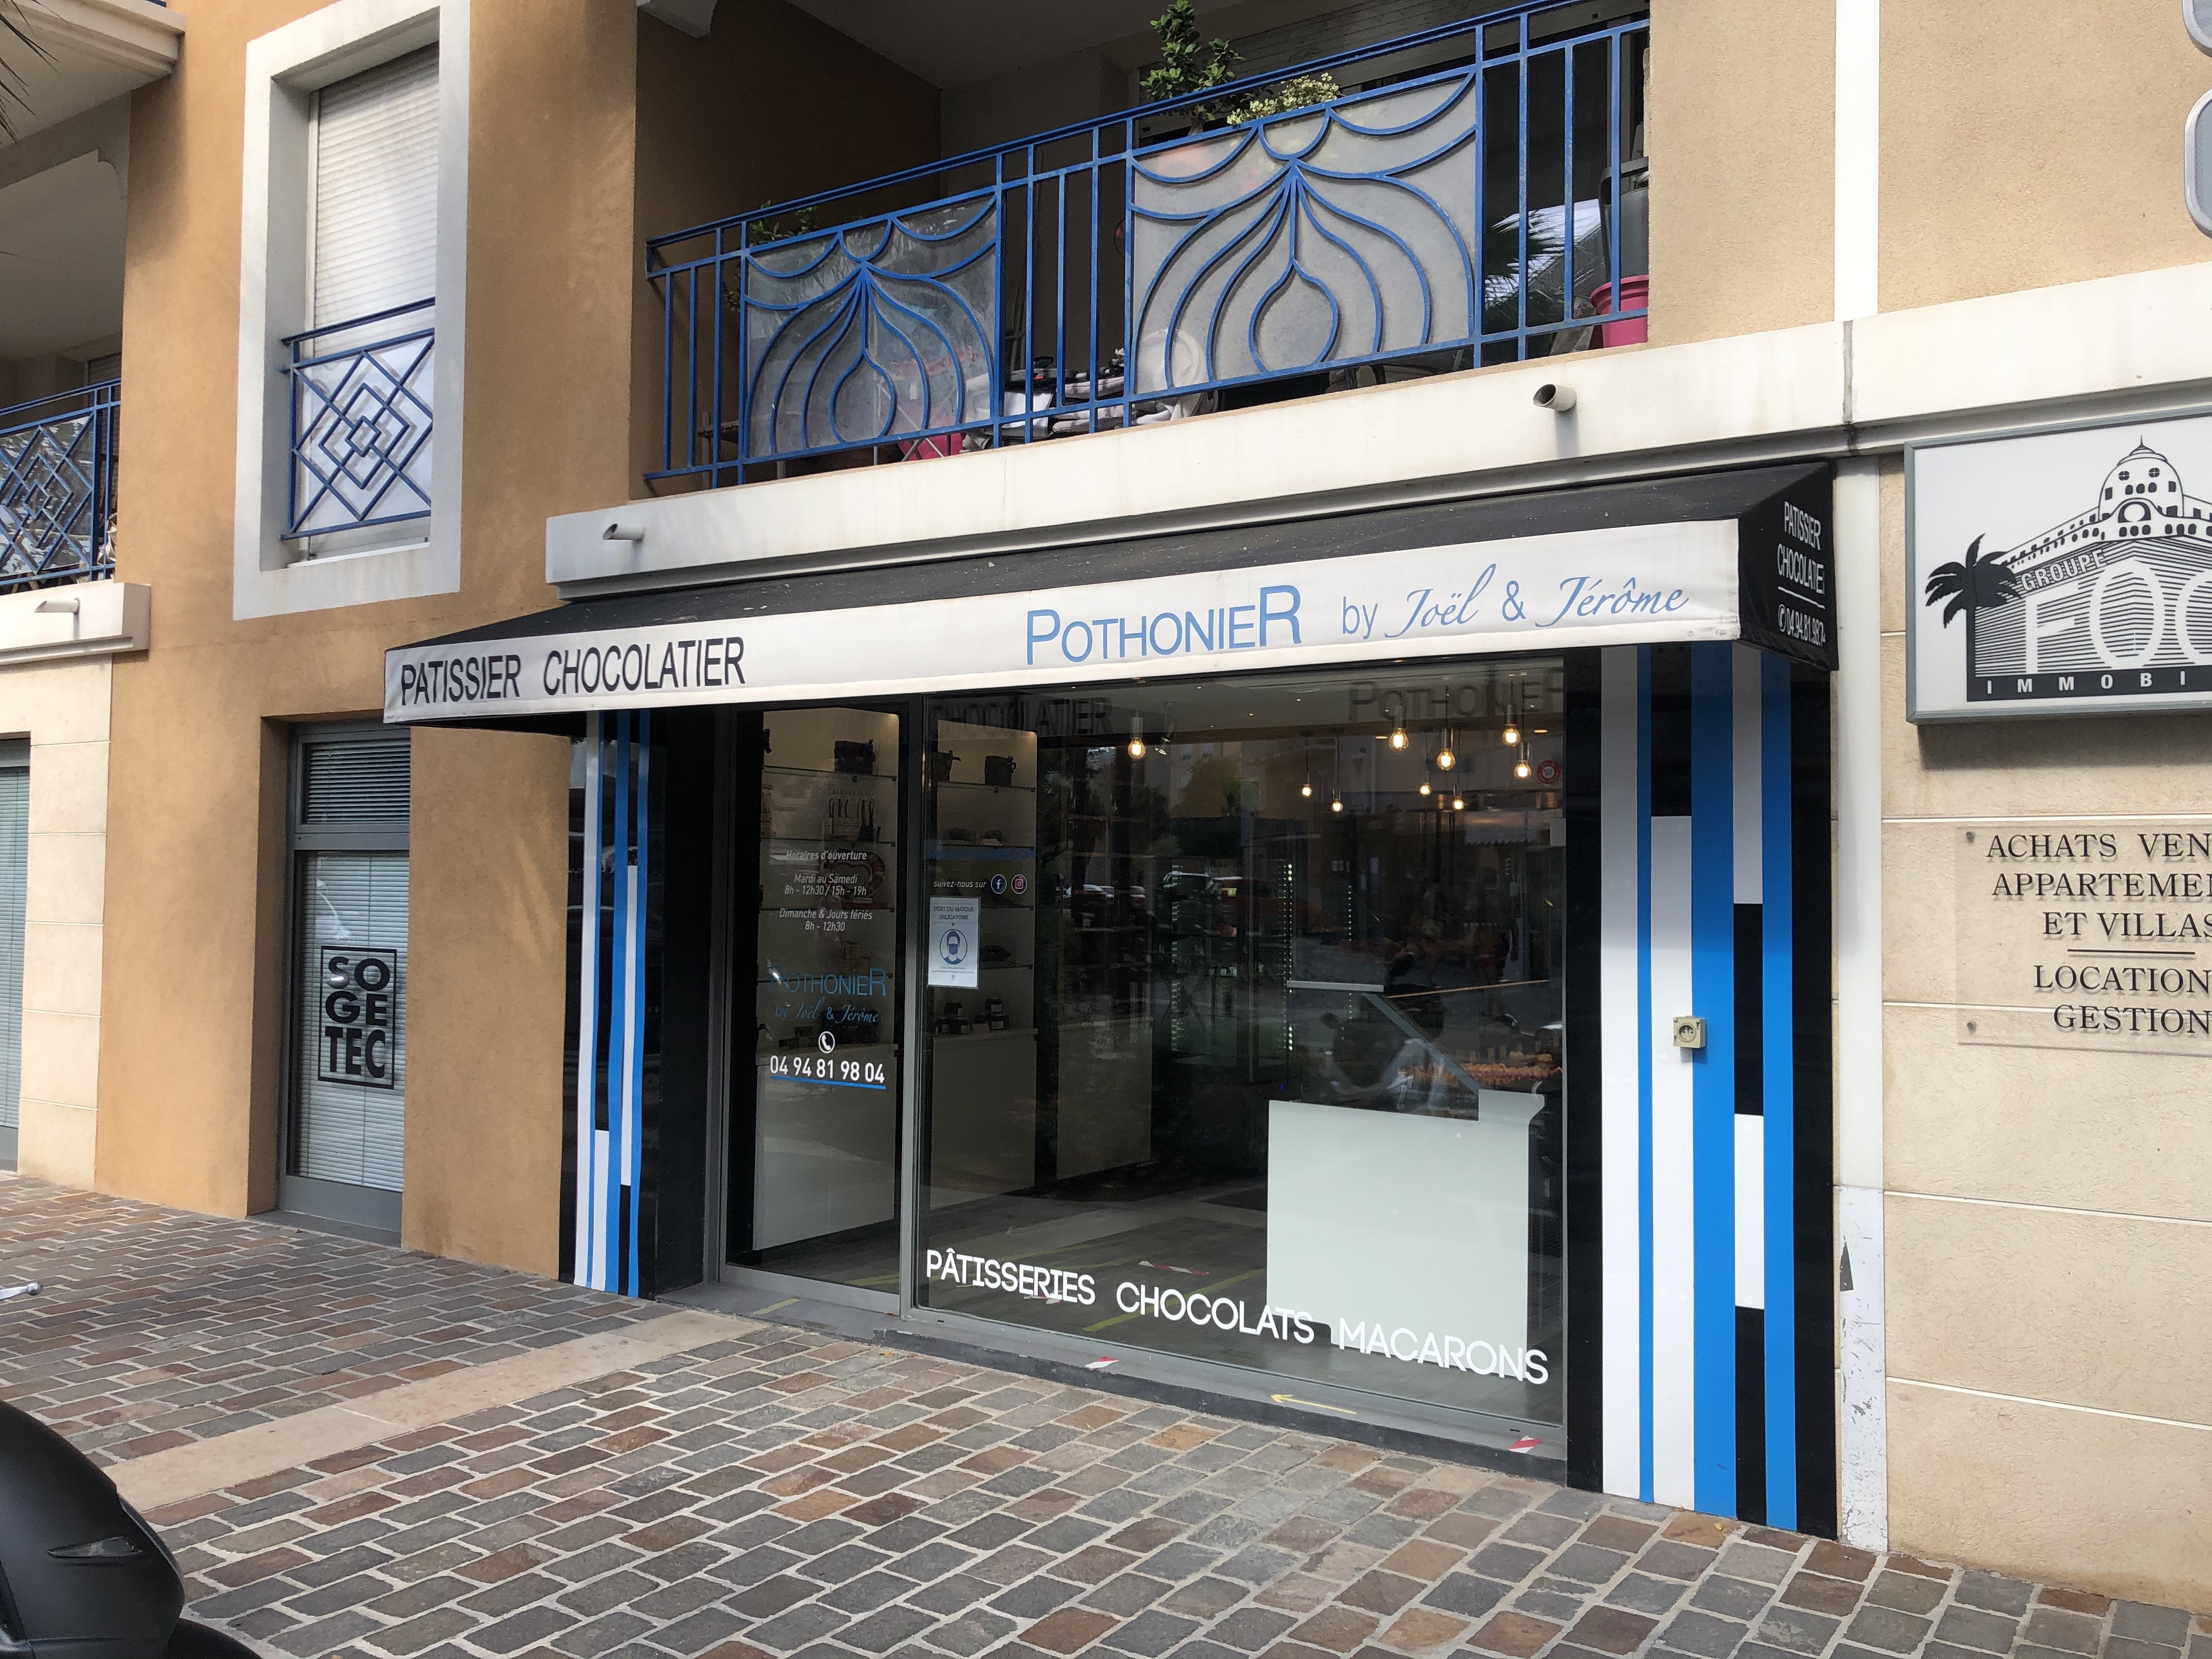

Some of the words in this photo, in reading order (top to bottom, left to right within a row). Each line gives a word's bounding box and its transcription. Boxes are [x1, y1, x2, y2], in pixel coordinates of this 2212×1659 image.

[2021, 549, 2108, 592] GROUPE
[1027, 585, 1302, 665] POTHONIER
[1342, 596, 1378, 640] by
[1384, 563, 1497, 638] Joël
[1502, 580, 1527, 622] &
[1535, 576, 1689, 628] Jérôme
[401, 653, 521, 706] PATISSIER
[543, 636, 746, 696] CHOCOLATIER
[786, 850, 819, 860] Horaires
[821, 850, 867, 860] d'ouverture
[1985, 833, 2117, 859] ACHATS
[2137, 832, 2212, 857] VEN
[785, 885, 794, 895] 8h
[803, 885, 824, 895] 12h30
[832, 885, 844, 895] 15h
[854, 886, 867, 896] 19h
[794, 873, 816, 884] Mardi
[828, 873, 858, 884] Samedi
[1991, 872, 2212, 898] APPARTEME
[780, 907, 816, 919] Dimanche
[819, 909, 825, 918] &
[827, 909, 849, 919] Jours
[850, 909, 873, 920] fériés
[805, 921, 814, 931] 8h
[823, 922, 845, 932] 12h30
[2042, 911, 2087, 936] ET
[770, 964, 887, 996] POTHONIER
[2033, 964, 2211, 995] LOCATION
[775, 1004, 788, 1019] by
[794, 996, 825, 1019] Joël
[826, 1006, 834, 1020] &
[836, 1004, 879, 1024] Jérôme
[2053, 1004, 2212, 1035] GESTION
[770, 1055, 788, 1075] 04
[793, 1057, 812, 1076] 94
[816, 1059, 833, 1079] 81
[840, 1060, 860, 1081] 98
[865, 1063, 884, 1084] 04
[927, 1248, 1096, 1305] PÂTISSERIES
[1116, 1282, 1315, 1344] CHOCOLATS
[1339, 1317, 1549, 1385] MACARONS
